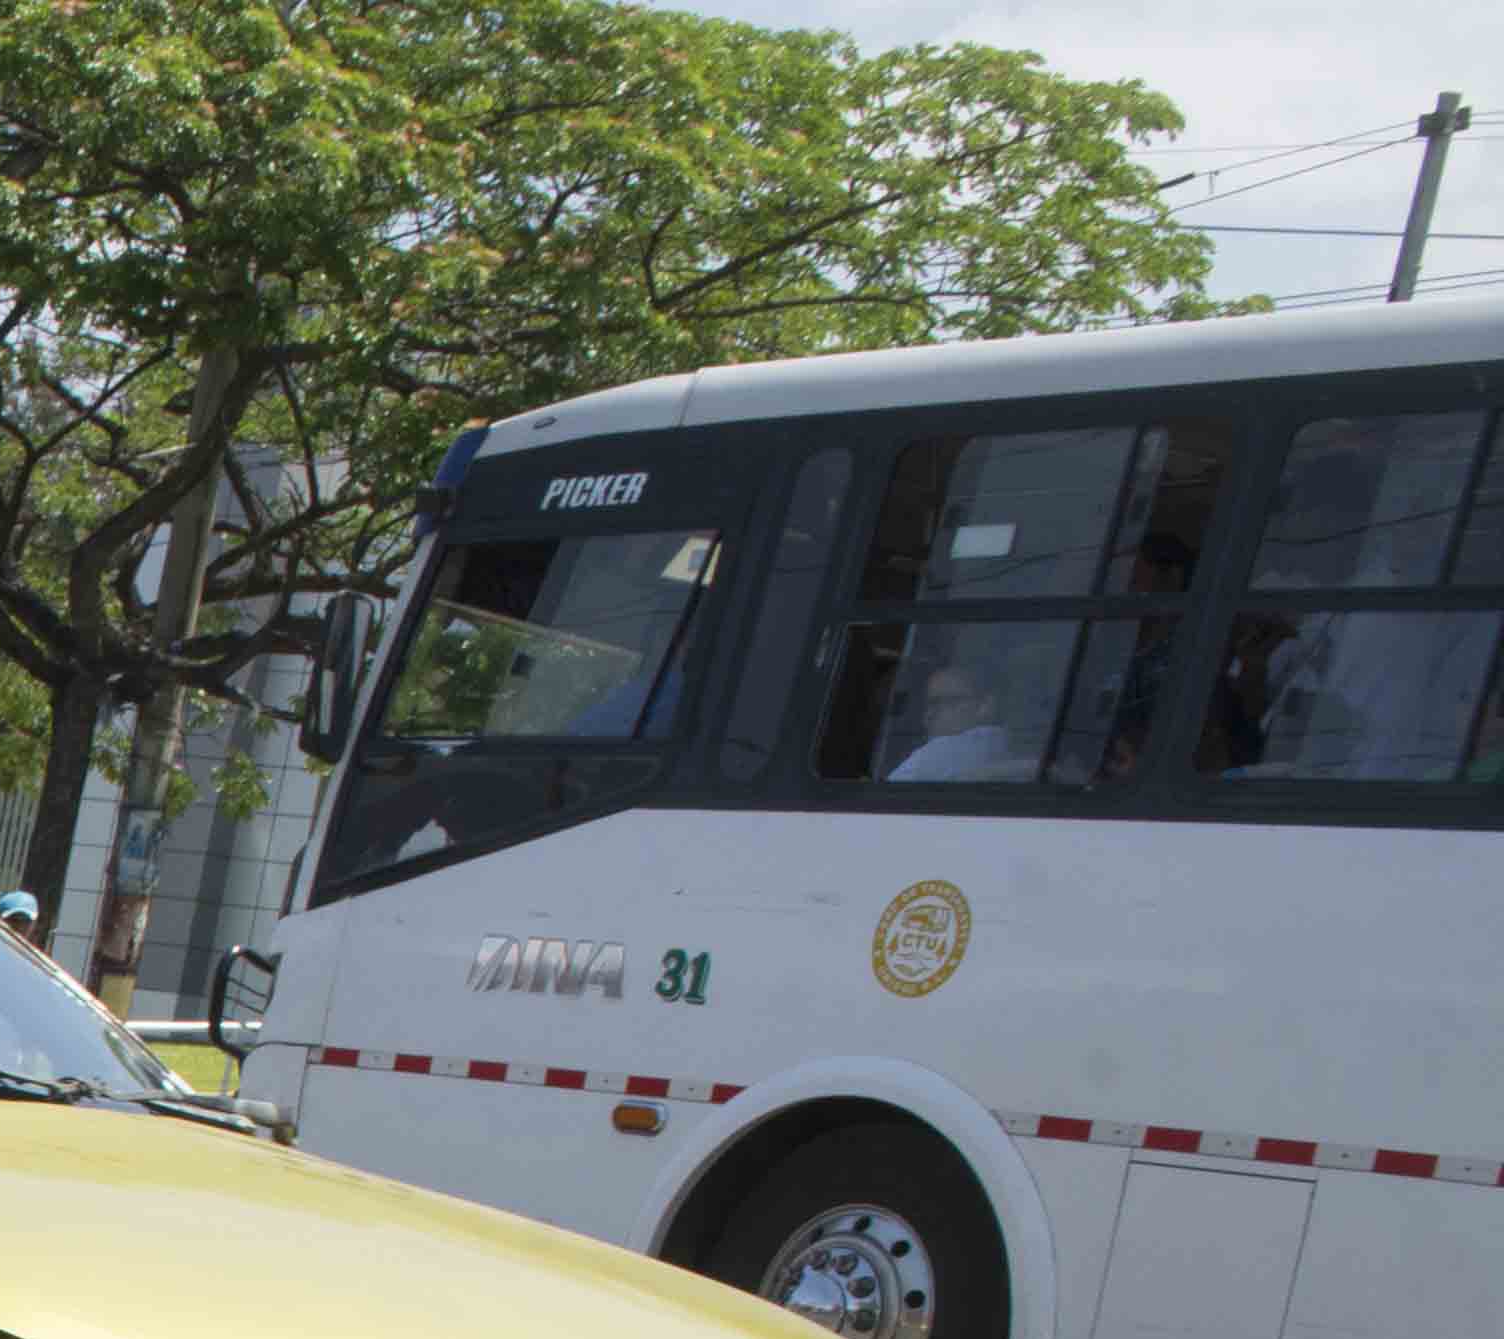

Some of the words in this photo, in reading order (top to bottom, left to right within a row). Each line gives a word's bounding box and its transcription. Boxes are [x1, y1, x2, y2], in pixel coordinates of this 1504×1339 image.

[541, 473, 649, 511] PICKER
[465, 931, 625, 999] DINA
[655, 947, 711, 1005] 31
